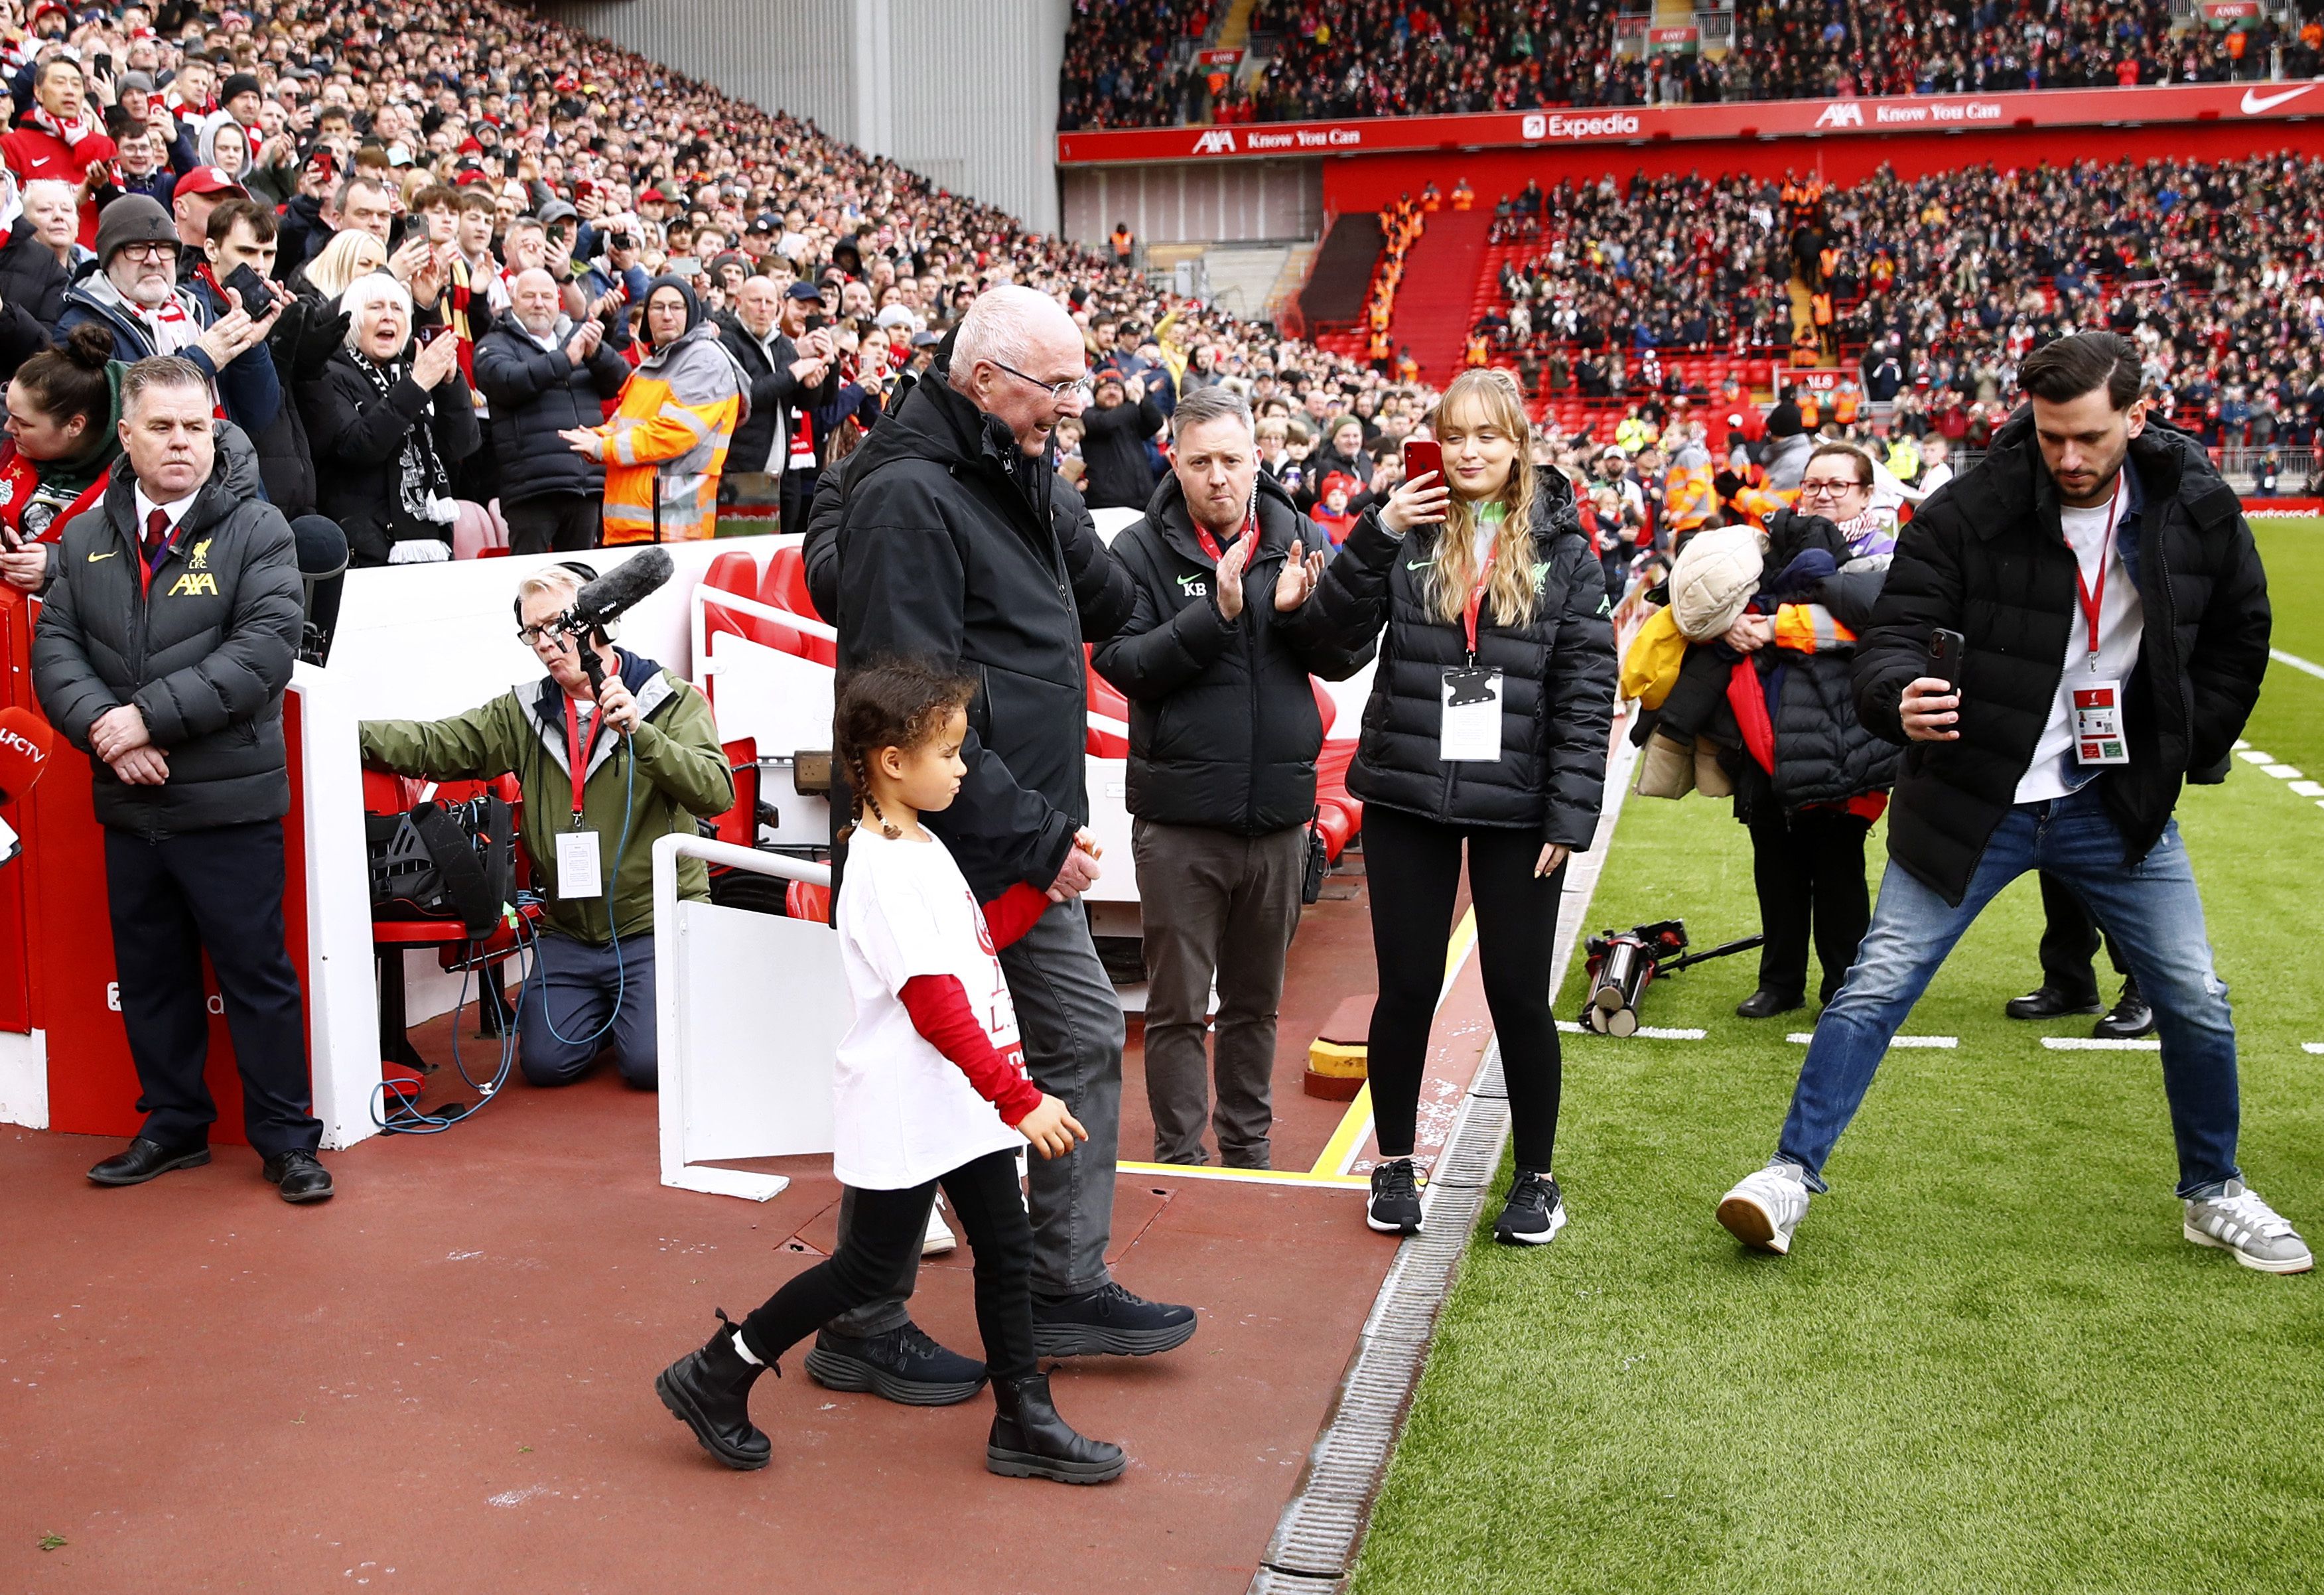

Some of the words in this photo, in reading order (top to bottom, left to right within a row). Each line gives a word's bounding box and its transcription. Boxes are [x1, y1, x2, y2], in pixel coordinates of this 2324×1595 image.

[1814, 102, 1864, 127] AXA
[1876, 105, 1927, 122] Know
[1929, 103, 1964, 121] You
[1966, 102, 2002, 119] Can
[1548, 113, 1639, 139] Expedia
[1192, 130, 1236, 154] AXA
[1247, 132, 1294, 149] Know
[1296, 130, 1327, 146] You
[1328, 128, 1360, 145] Can
[167, 573, 218, 596] AXA
[1183, 583, 1207, 596] KB
[0, 727, 46, 764] LFCTV
